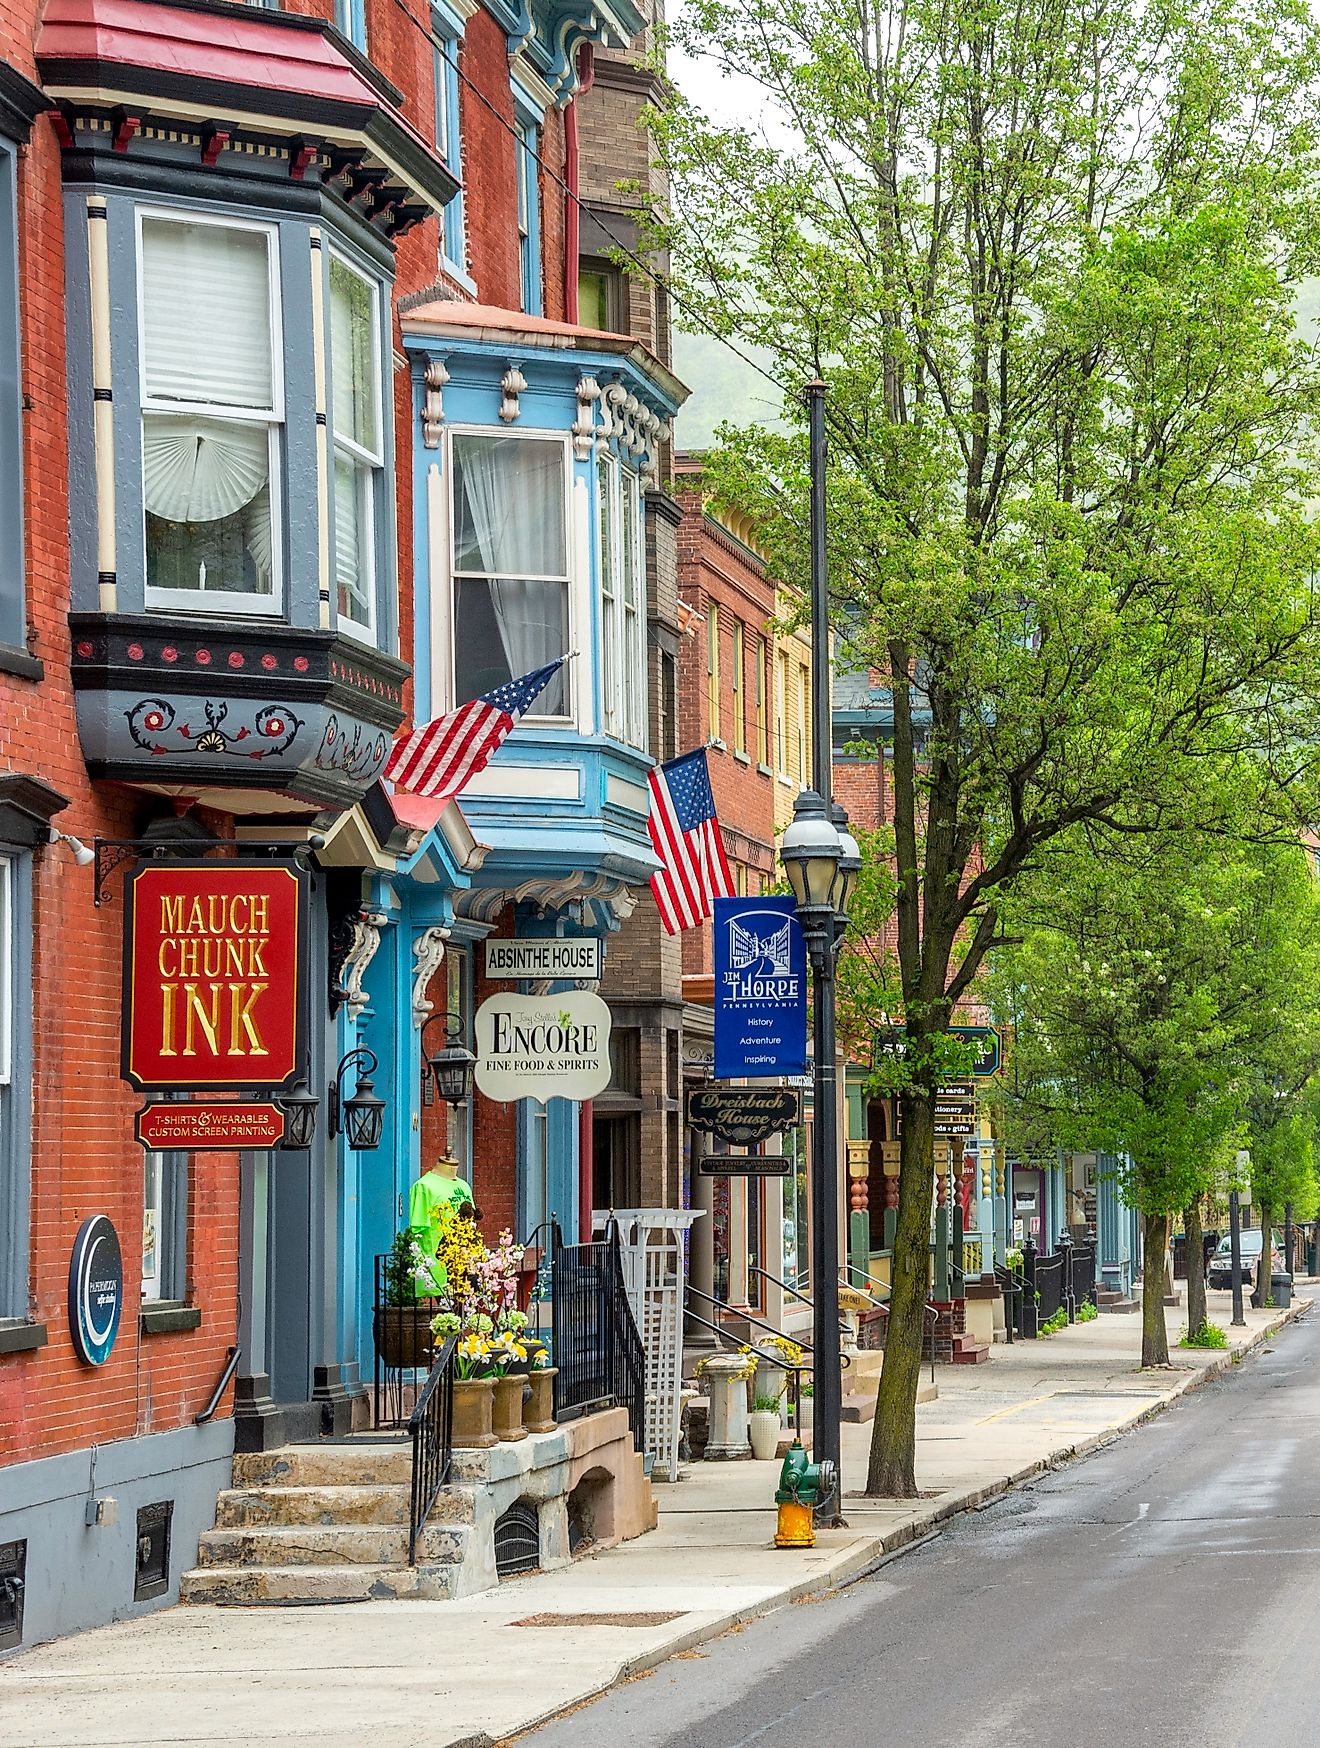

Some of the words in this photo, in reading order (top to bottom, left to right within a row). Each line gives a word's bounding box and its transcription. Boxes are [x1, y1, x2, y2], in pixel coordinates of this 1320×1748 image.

[159, 894, 271, 934] MAUCH
[158, 937, 270, 978] CHUNK
[488, 947, 550, 969] ABSINTHE
[552, 947, 594, 968] HOUSE
[722, 971, 740, 984] JIM
[726, 972, 799, 1003] THORPE
[159, 982, 271, 1056] INK
[747, 1018, 774, 1028] History
[489, 1012, 598, 1056] ENCORE
[739, 1037, 782, 1045] Adventure
[486, 1060, 512, 1071] FINE
[514, 1060, 545, 1071] FOOD
[546, 1060, 555, 1071] &
[557, 1060, 599, 1070] SPIRITS
[744, 1055, 777, 1065] Inspiring
[701, 1093, 785, 1109] Dreisbach
[155, 1115, 197, 1125] T-SHIRTS
[198, 1111, 213, 1126] &
[212, 1114, 269, 1124] WEARABLES
[716, 1108, 771, 1125] House
[148, 1127, 190, 1137] CUSTOM
[192, 1126, 229, 1136] SCREEN
[230, 1126, 275, 1136] PRINTING
[952, 1125, 970, 1134] gifts
